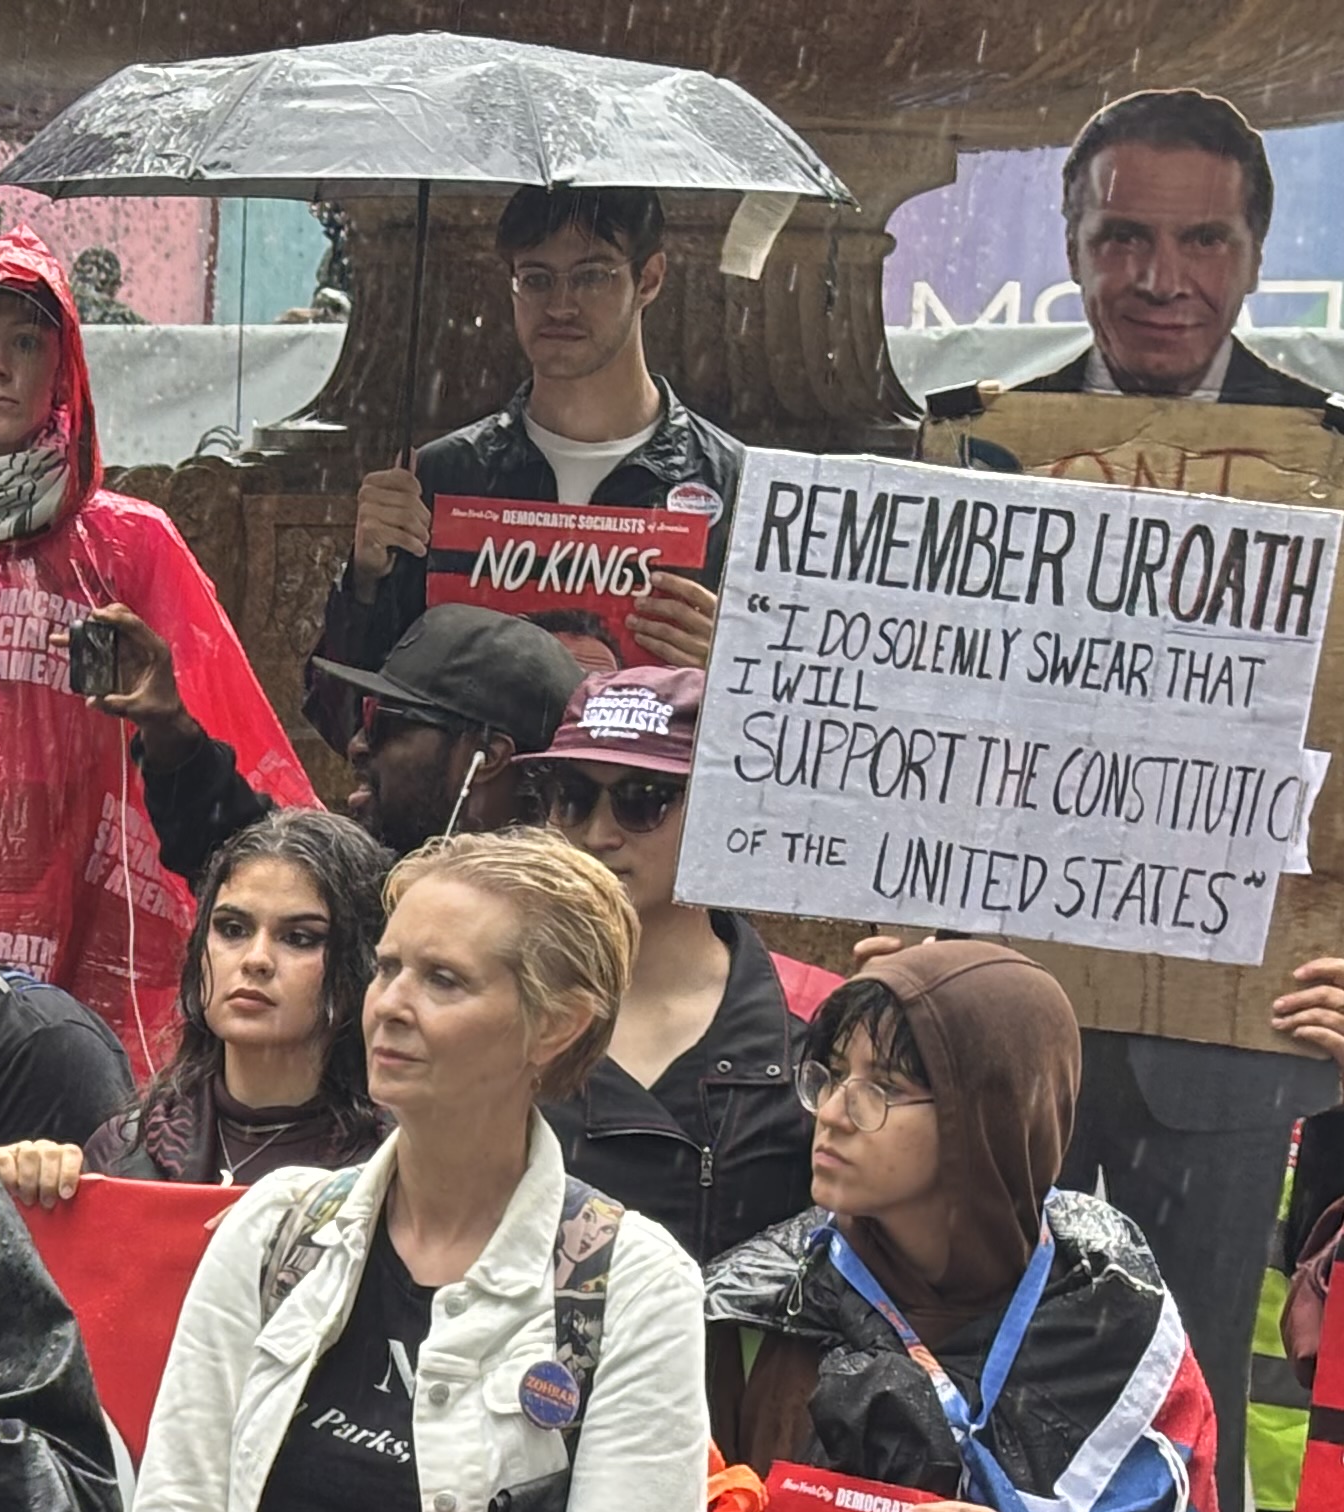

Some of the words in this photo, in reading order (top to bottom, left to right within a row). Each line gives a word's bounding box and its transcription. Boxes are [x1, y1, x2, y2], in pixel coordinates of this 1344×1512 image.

[502, 510, 576, 529] DEMOCRATIC
[578, 516, 645, 534] SOCIALISTS
[755, 481, 1076, 607] REMEMBER
[470, 536, 536, 592] NO
[537, 540, 661, 597] KINGS
[727, 656, 761, 695] I
[772, 660, 879, 712] WILL
[818, 609, 872, 659] DO
[1028, 631, 1153, 697] SWEAR
[1167, 646, 1265, 708] THAT
[733, 710, 967, 804] SUPPORT
[977, 735, 1051, 812] THE
[726, 827, 768, 856] OF
[782, 831, 847, 868] THE
[873, 832, 1047, 915] UNITED
[311, 1408, 411, 1464] Parks,
